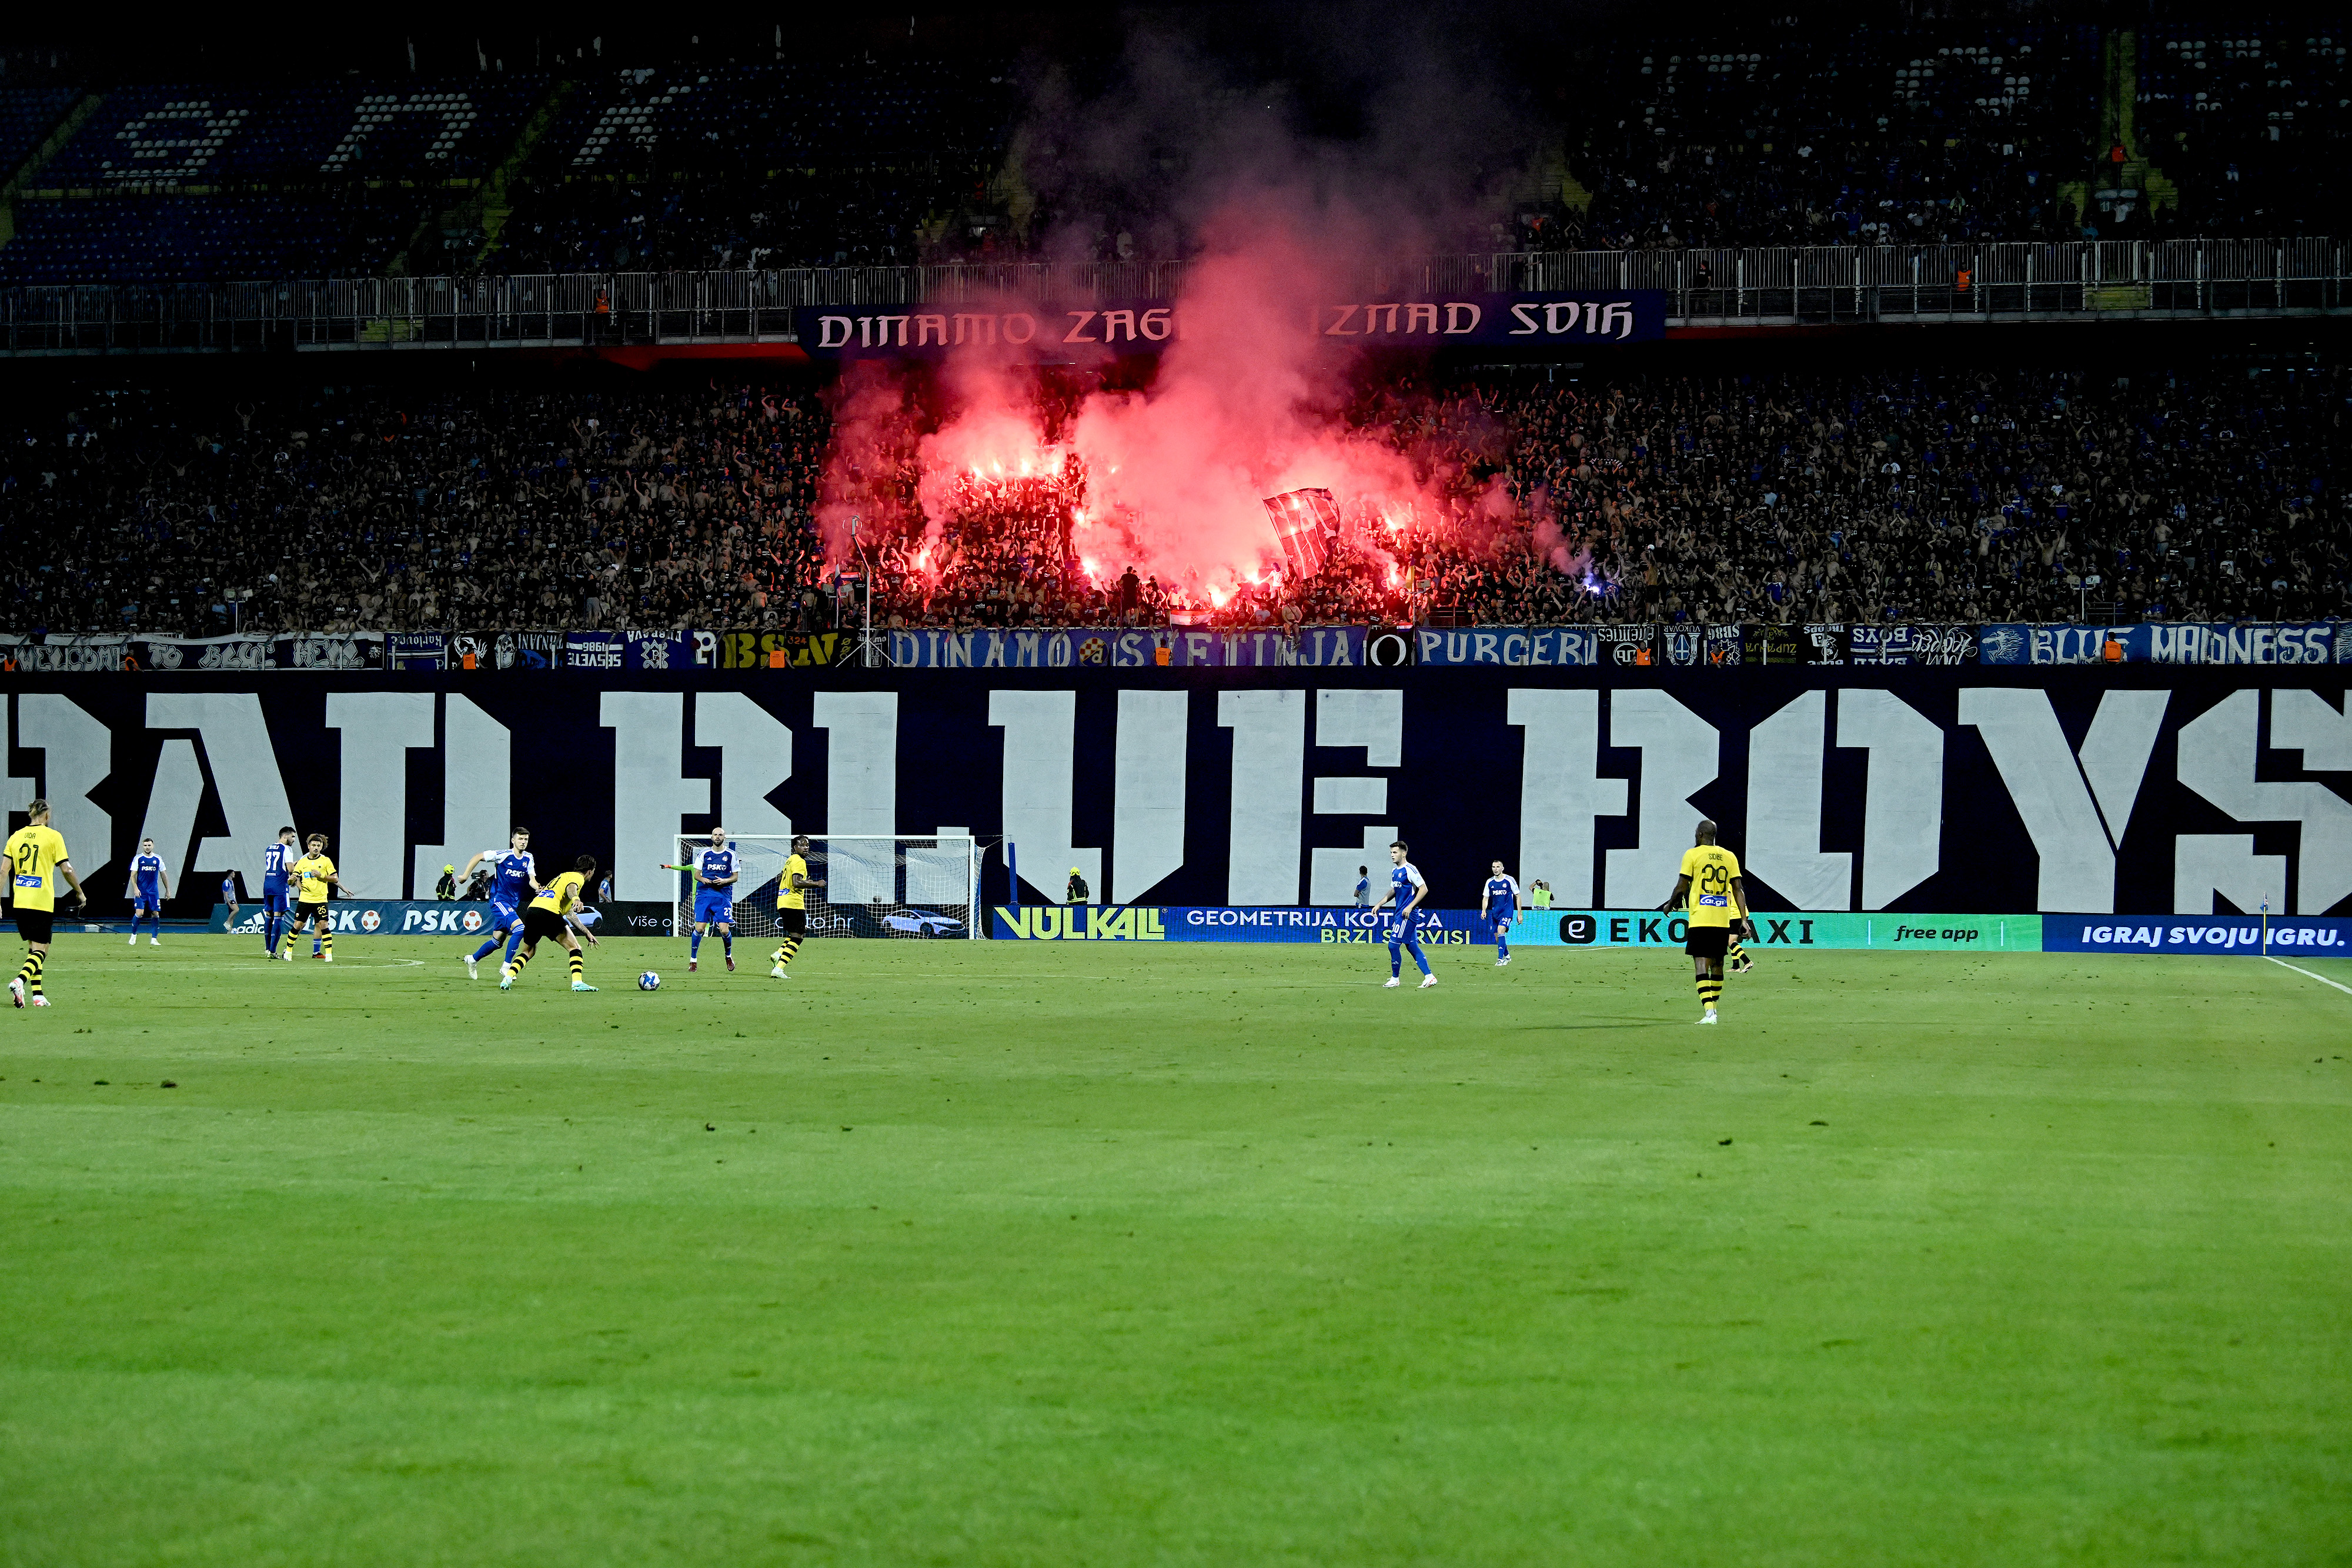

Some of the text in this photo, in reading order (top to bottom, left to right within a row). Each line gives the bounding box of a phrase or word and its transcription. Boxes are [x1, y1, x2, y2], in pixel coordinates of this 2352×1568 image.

[818, 312, 1037, 348] DINAMO
[1063, 308, 1172, 343] ZAG
[787, 635, 808, 644] 324
[1852, 626, 1908, 643] BOYS
[2149, 625, 2331, 664] MADNESS
[148, 643, 183, 669] TO
[582, 642, 606, 651] 1986
[893, 632, 1072, 667] DINAMO
[1417, 629, 1599, 666] PURGERI
[567, 652, 622, 668] SESVETE
[0, 688, 2352, 915] BAD BLUE BOYS
[19, 842, 39, 875] 21
[266, 851, 281, 871] 37
[505, 868, 522, 878] PSK
[1702, 864, 1729, 895] 29
[317, 905, 327, 915] 25
[723, 907, 732, 916] 27
[1186, 908, 1444, 928] GEOMETRIJA KOTČA
[403, 910, 462, 932] PSK
[627, 915, 658, 928] Više
[1610, 918, 1814, 944] EKOAXI
[1321, 929, 1471, 944] BRZI SRVISI
[1893, 925, 1979, 942] free app
[2081, 925, 2346, 949] IGRAJ SVOJU IGRU.
